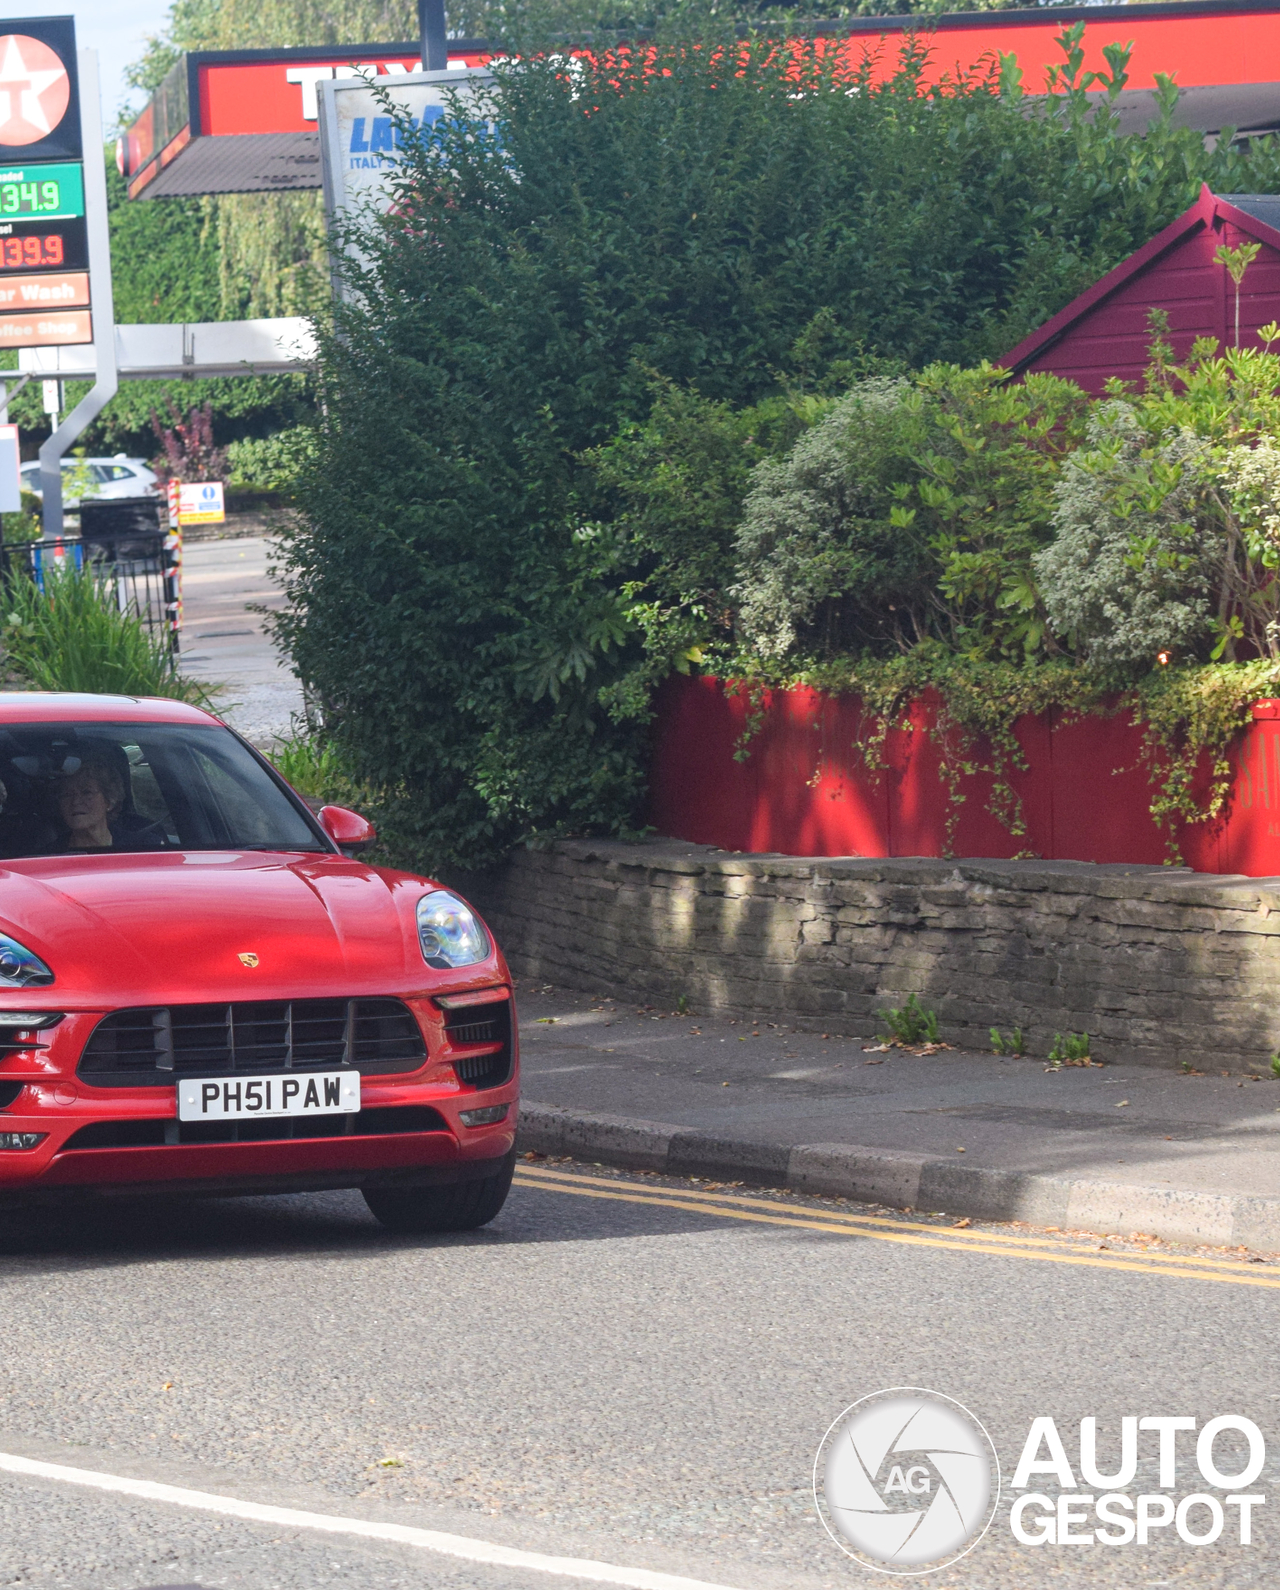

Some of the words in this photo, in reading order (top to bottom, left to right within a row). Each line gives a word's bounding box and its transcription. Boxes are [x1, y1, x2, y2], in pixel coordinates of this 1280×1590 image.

[21, 283, 76, 301] Wash
[37, 321, 77, 337] Shop
[201, 1080, 271, 1113] PH51
[282, 1077, 341, 1109] PAW
